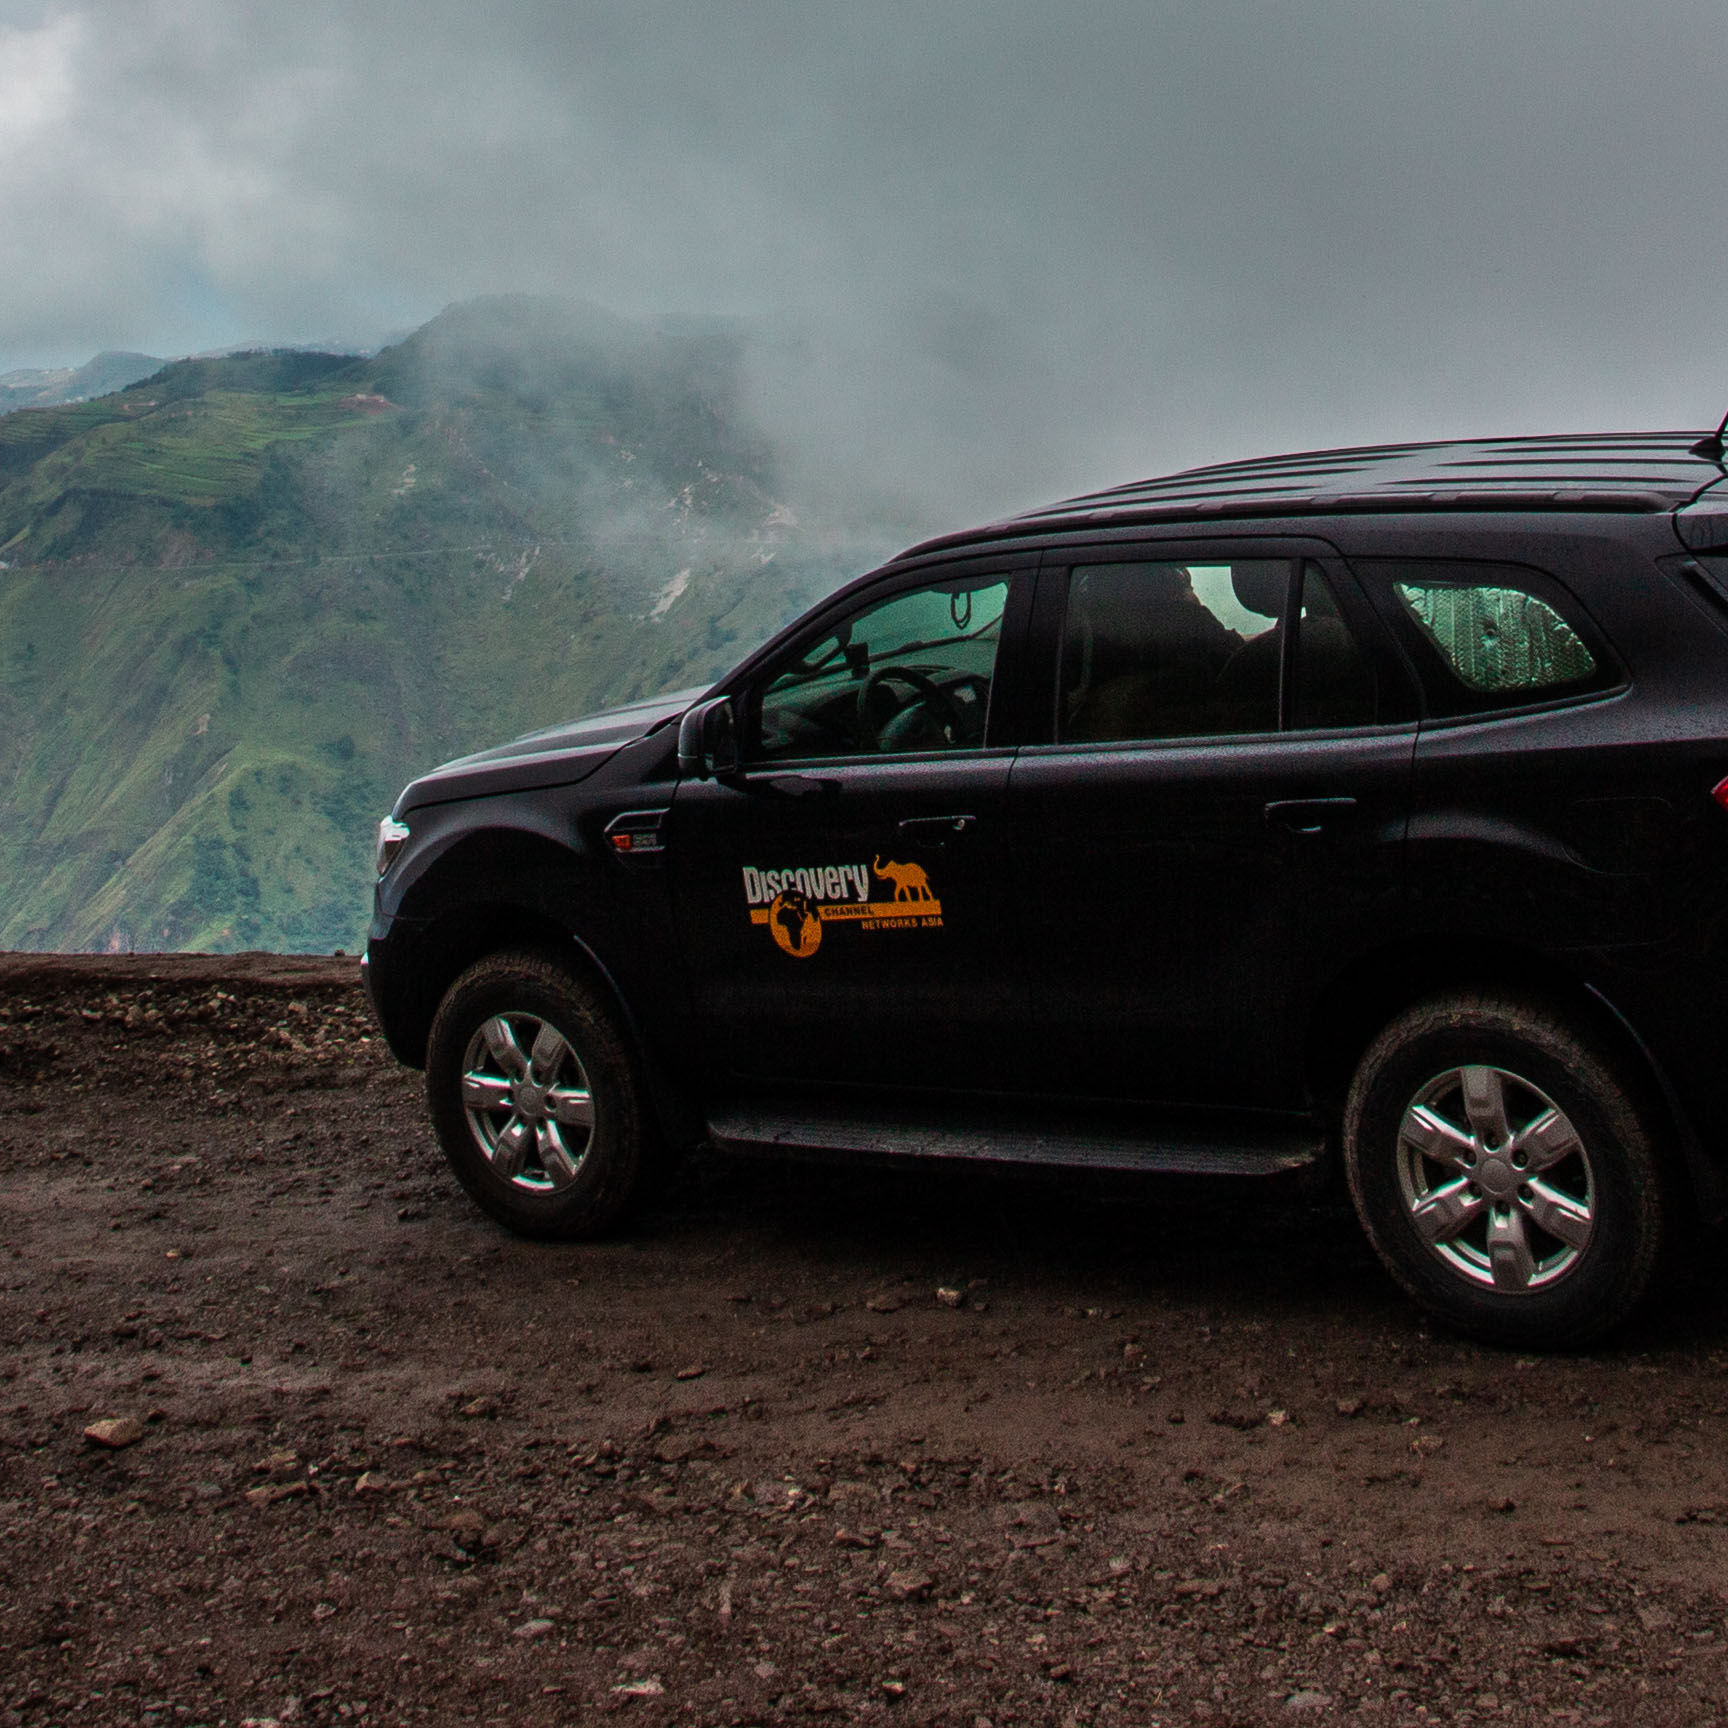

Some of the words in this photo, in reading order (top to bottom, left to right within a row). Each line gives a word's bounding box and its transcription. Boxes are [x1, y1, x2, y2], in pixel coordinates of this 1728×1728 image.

[742, 864, 869, 904] Discovery
[824, 906, 874, 917] CHANNEL
[861, 918, 918, 930] NETWORKS
[921, 916, 944, 928] ASIA
